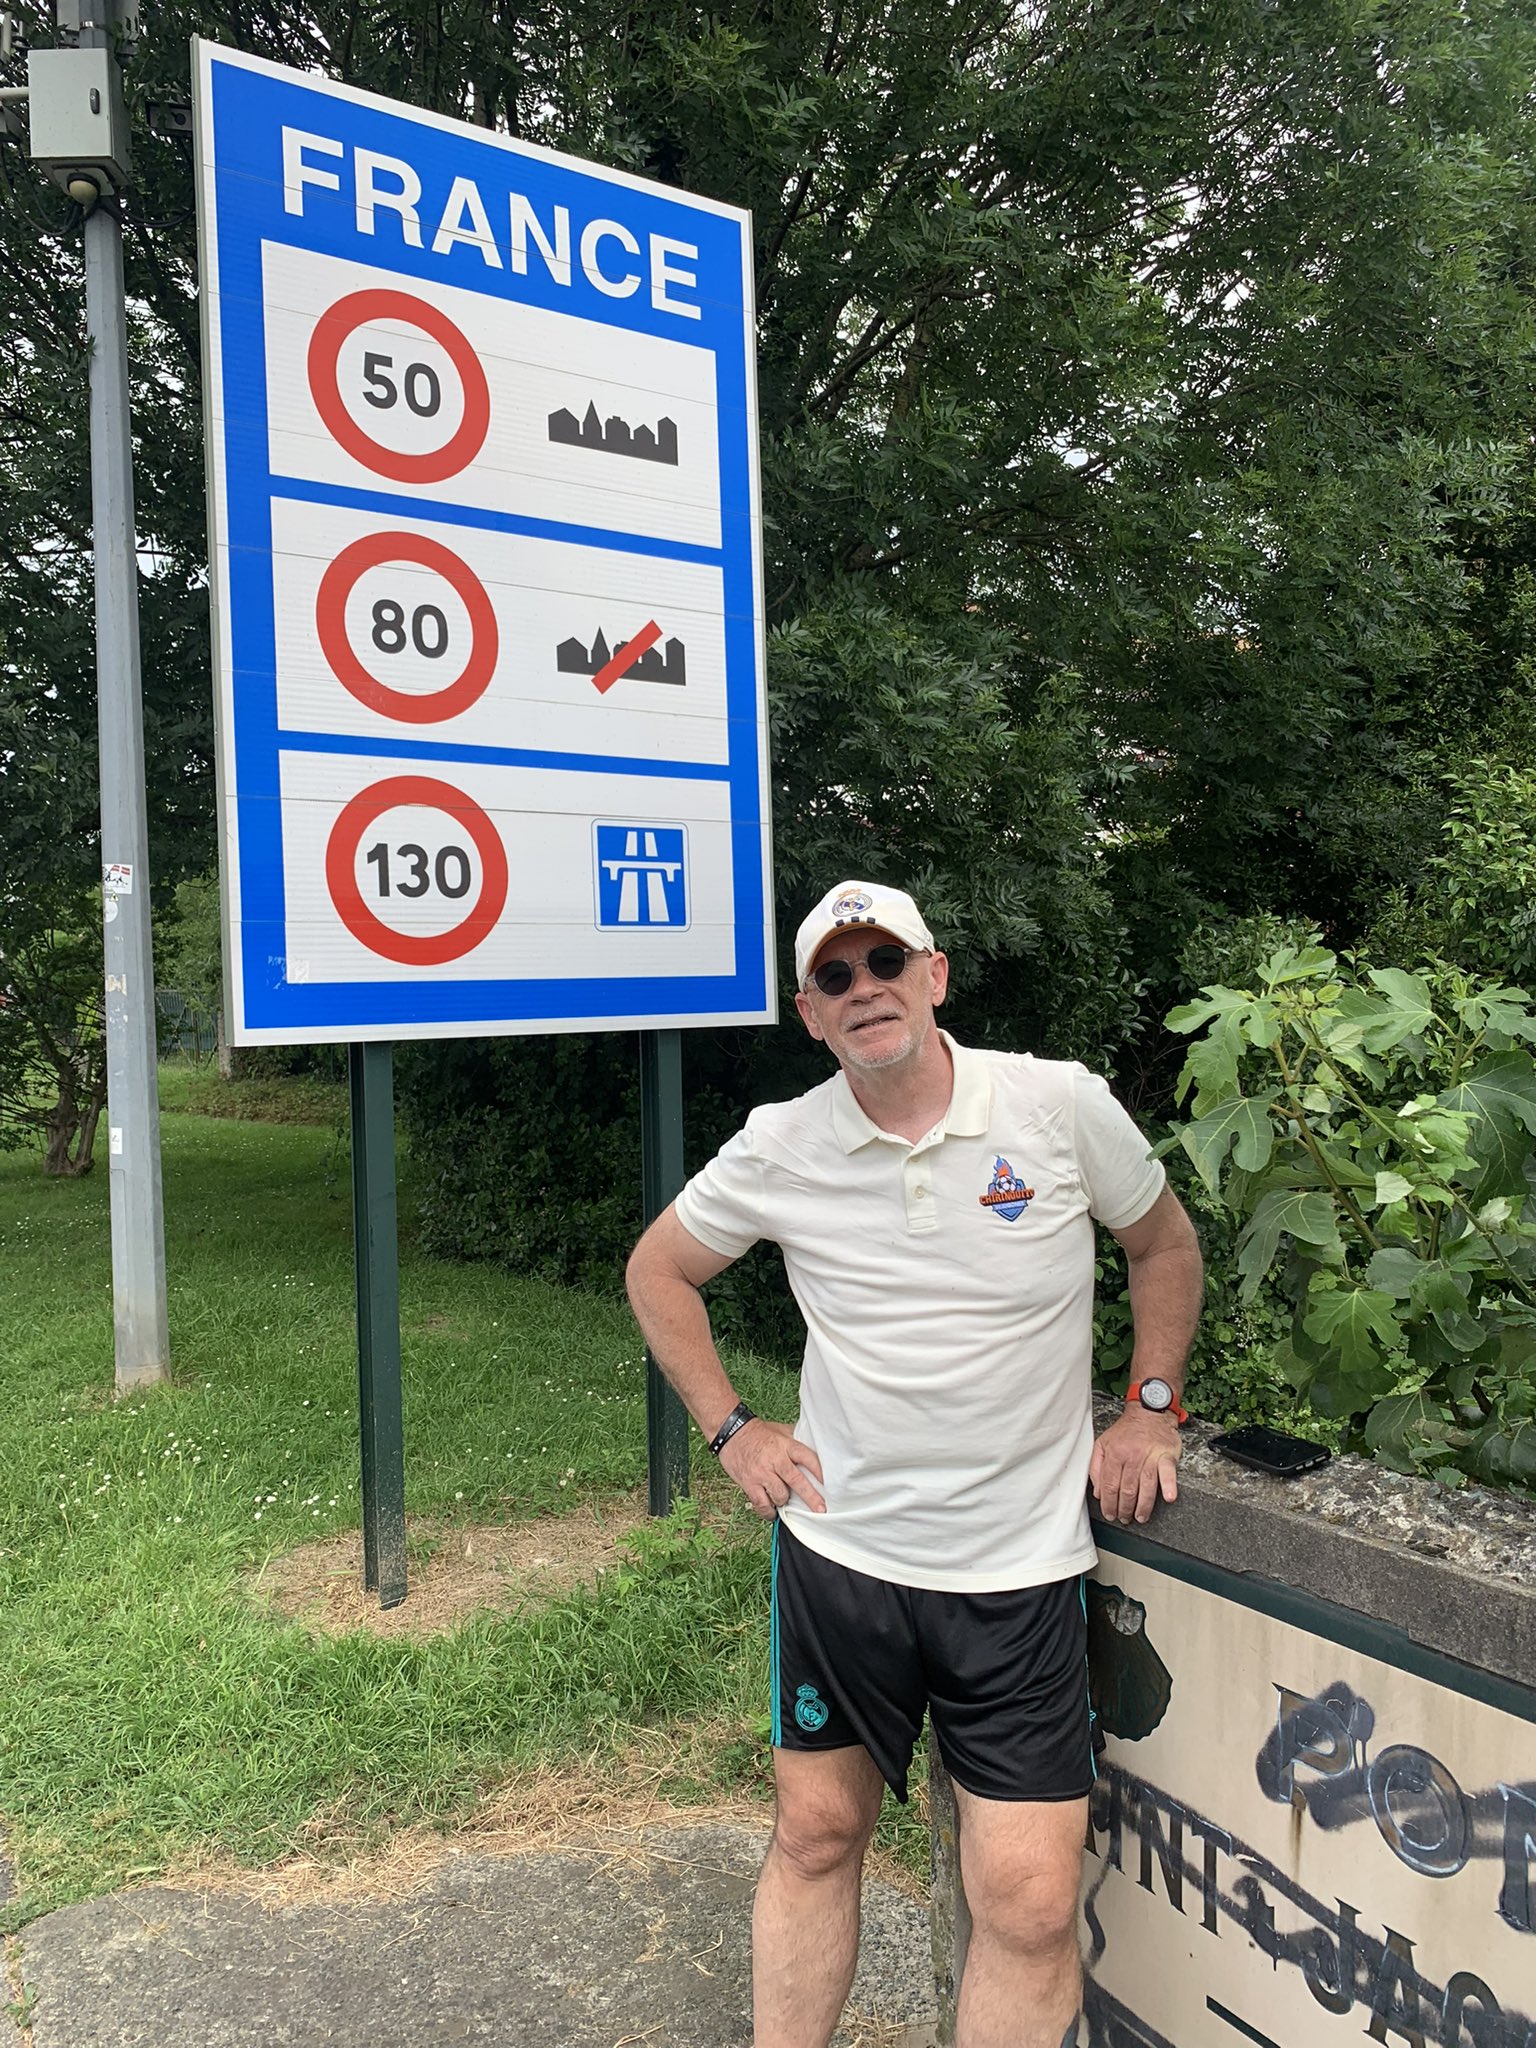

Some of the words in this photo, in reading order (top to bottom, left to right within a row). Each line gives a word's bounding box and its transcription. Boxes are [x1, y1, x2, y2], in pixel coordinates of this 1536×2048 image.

[282, 125, 702, 320] FRANCE
[362, 351, 442, 418] 50
[370, 599, 448, 659] 80
[366, 843, 472, 899] 130
